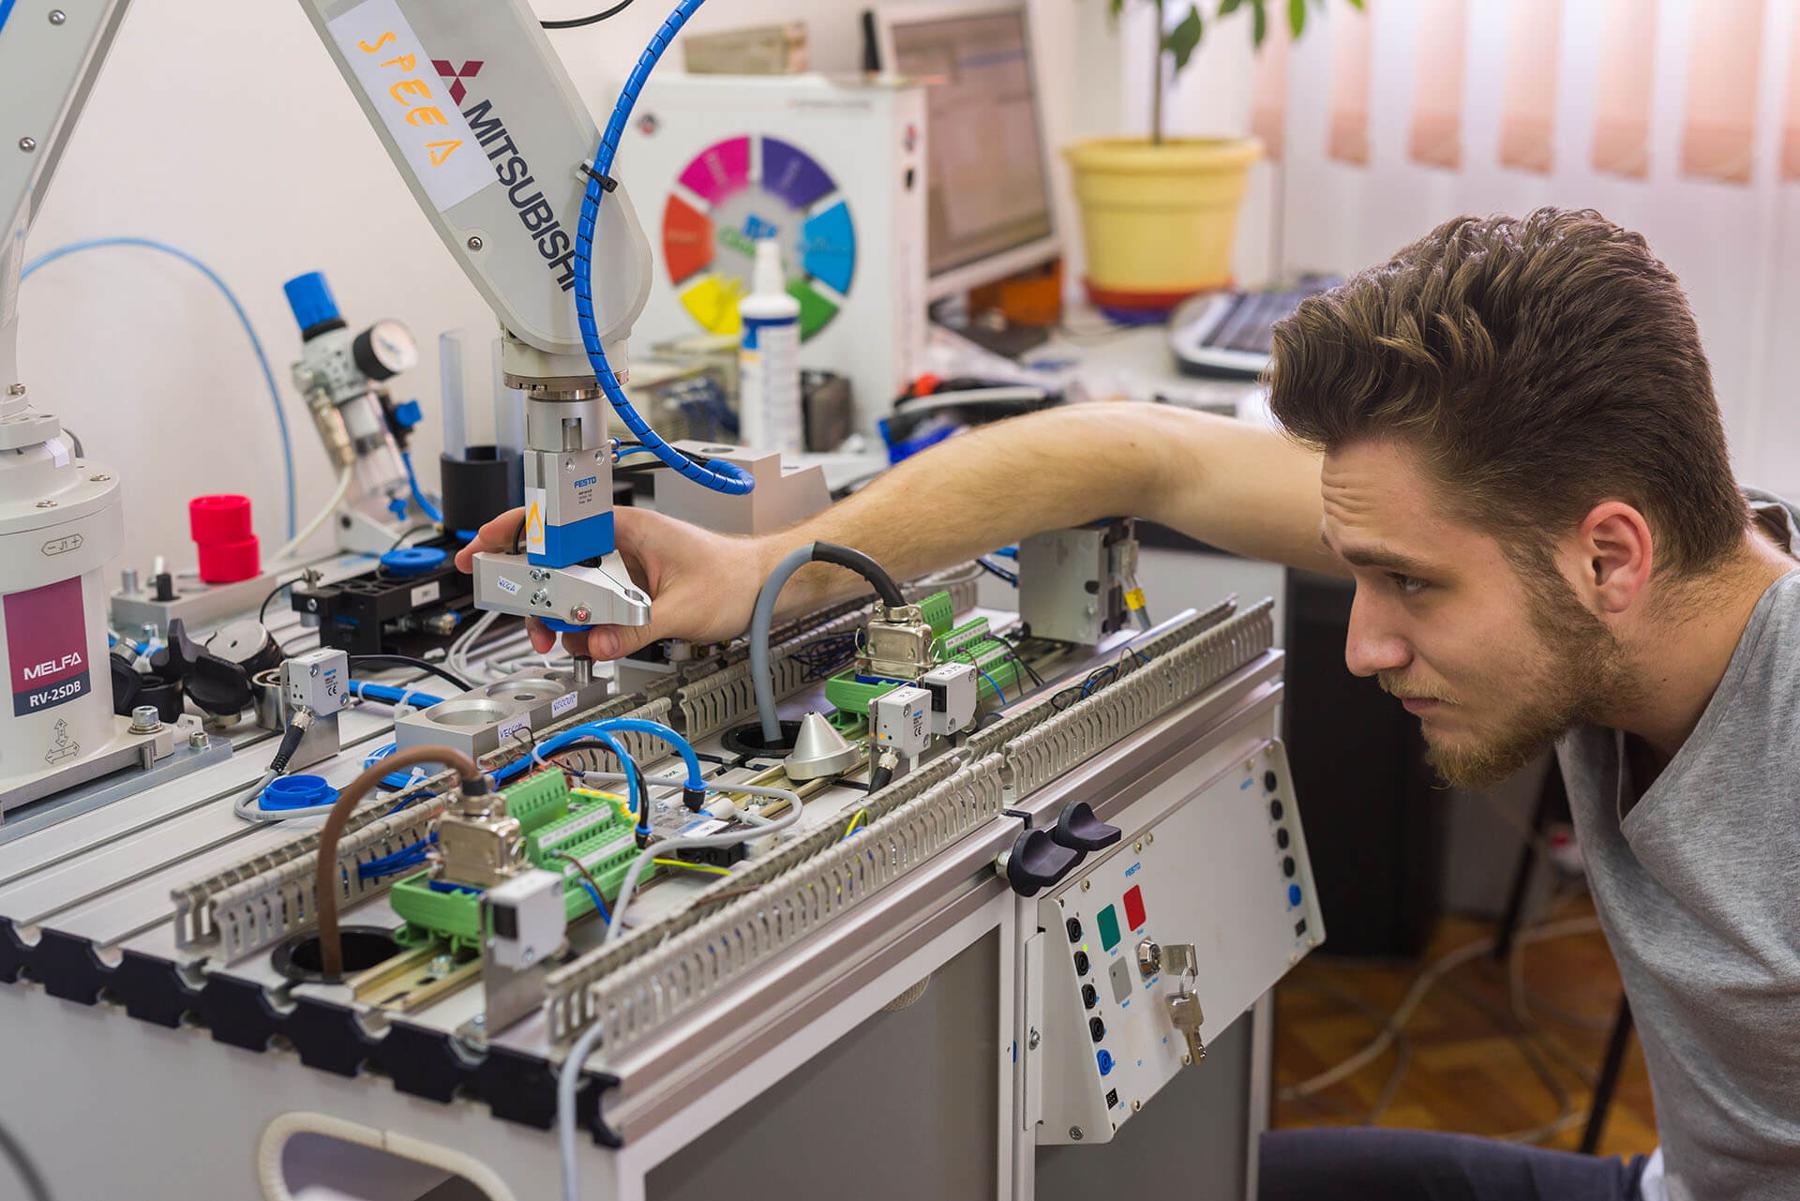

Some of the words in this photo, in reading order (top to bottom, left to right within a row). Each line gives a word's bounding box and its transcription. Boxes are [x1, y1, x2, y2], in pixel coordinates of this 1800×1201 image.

[574, 476, 597, 489] FESTO
[23, 651, 82, 681] MELFA
[29, 680, 82, 708] RV-2SDB
